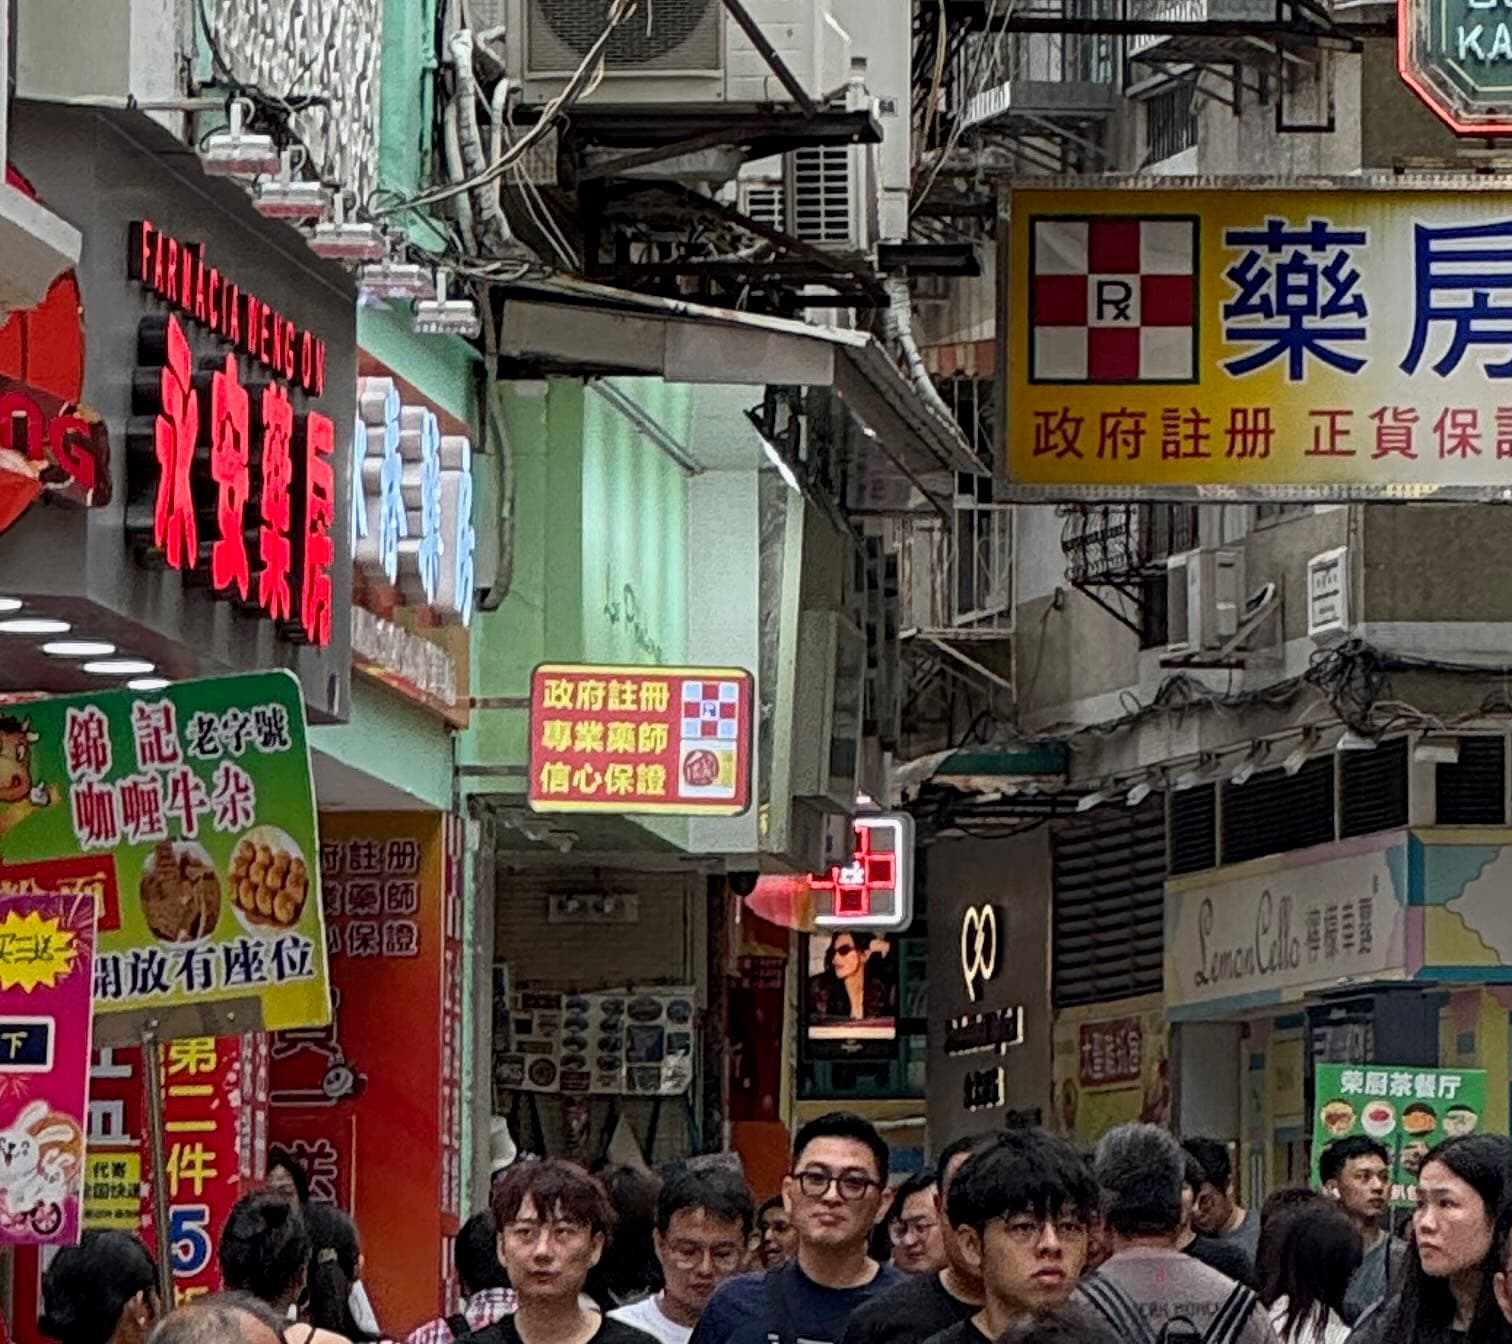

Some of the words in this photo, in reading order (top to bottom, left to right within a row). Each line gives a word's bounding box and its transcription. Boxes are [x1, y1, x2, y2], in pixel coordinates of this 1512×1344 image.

[65, 701, 181, 776] 錦記
[73, 763, 254, 846] 咖喱牛杂
[540, 761, 667, 796] 信心保證
[1194, 888, 1301, 988] LemonCello
